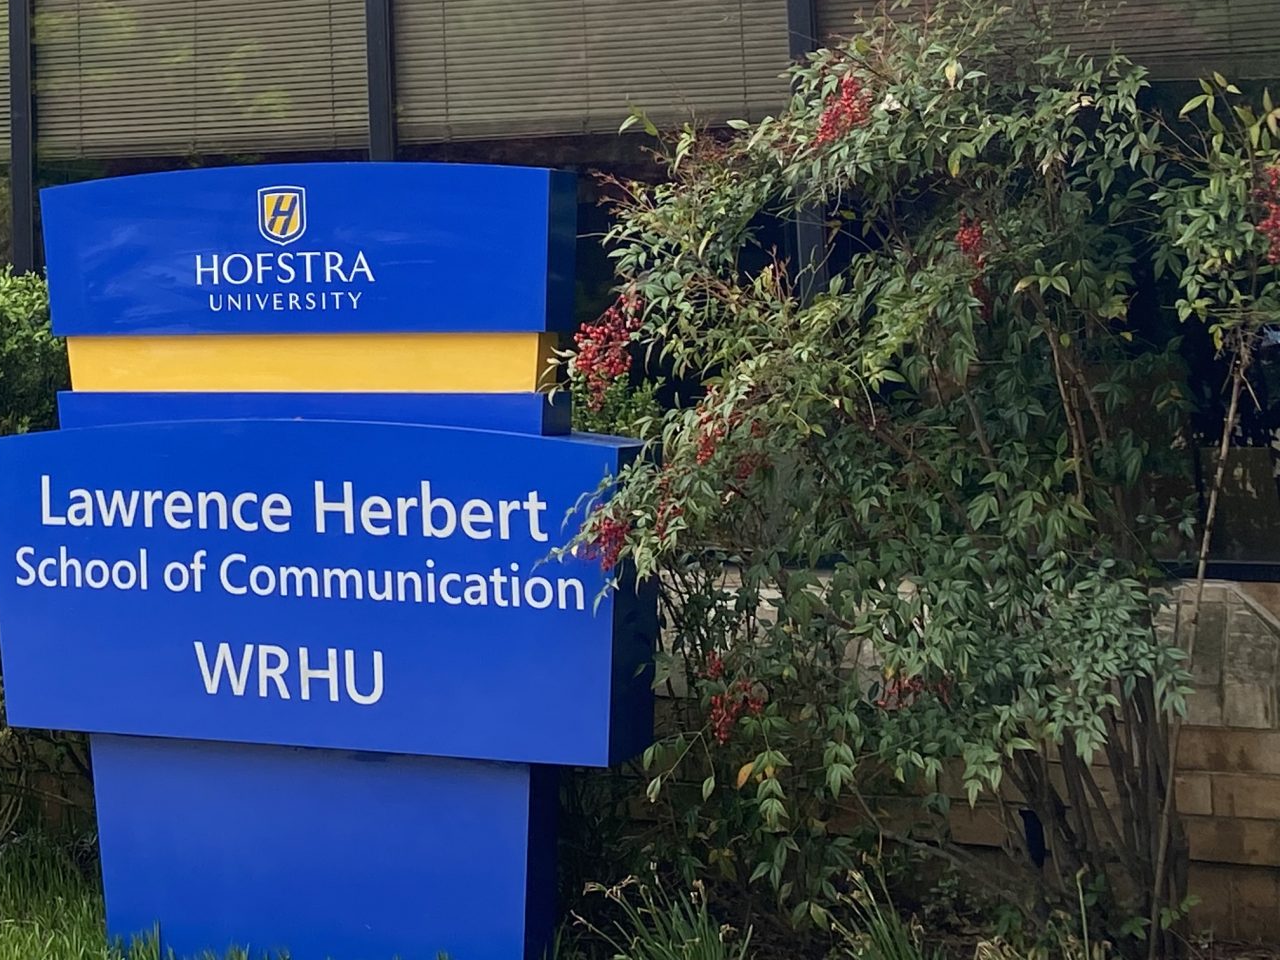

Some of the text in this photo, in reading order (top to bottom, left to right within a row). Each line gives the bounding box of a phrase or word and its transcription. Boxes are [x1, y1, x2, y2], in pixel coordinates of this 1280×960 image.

[195, 251, 375, 285] HOFSTRA
[209, 292, 362, 311] UNIVERSITY
[40, 475, 548, 542] Lawrence Herbert
[15, 546, 585, 610] School of Communication
[194, 641, 385, 705] WRHU
